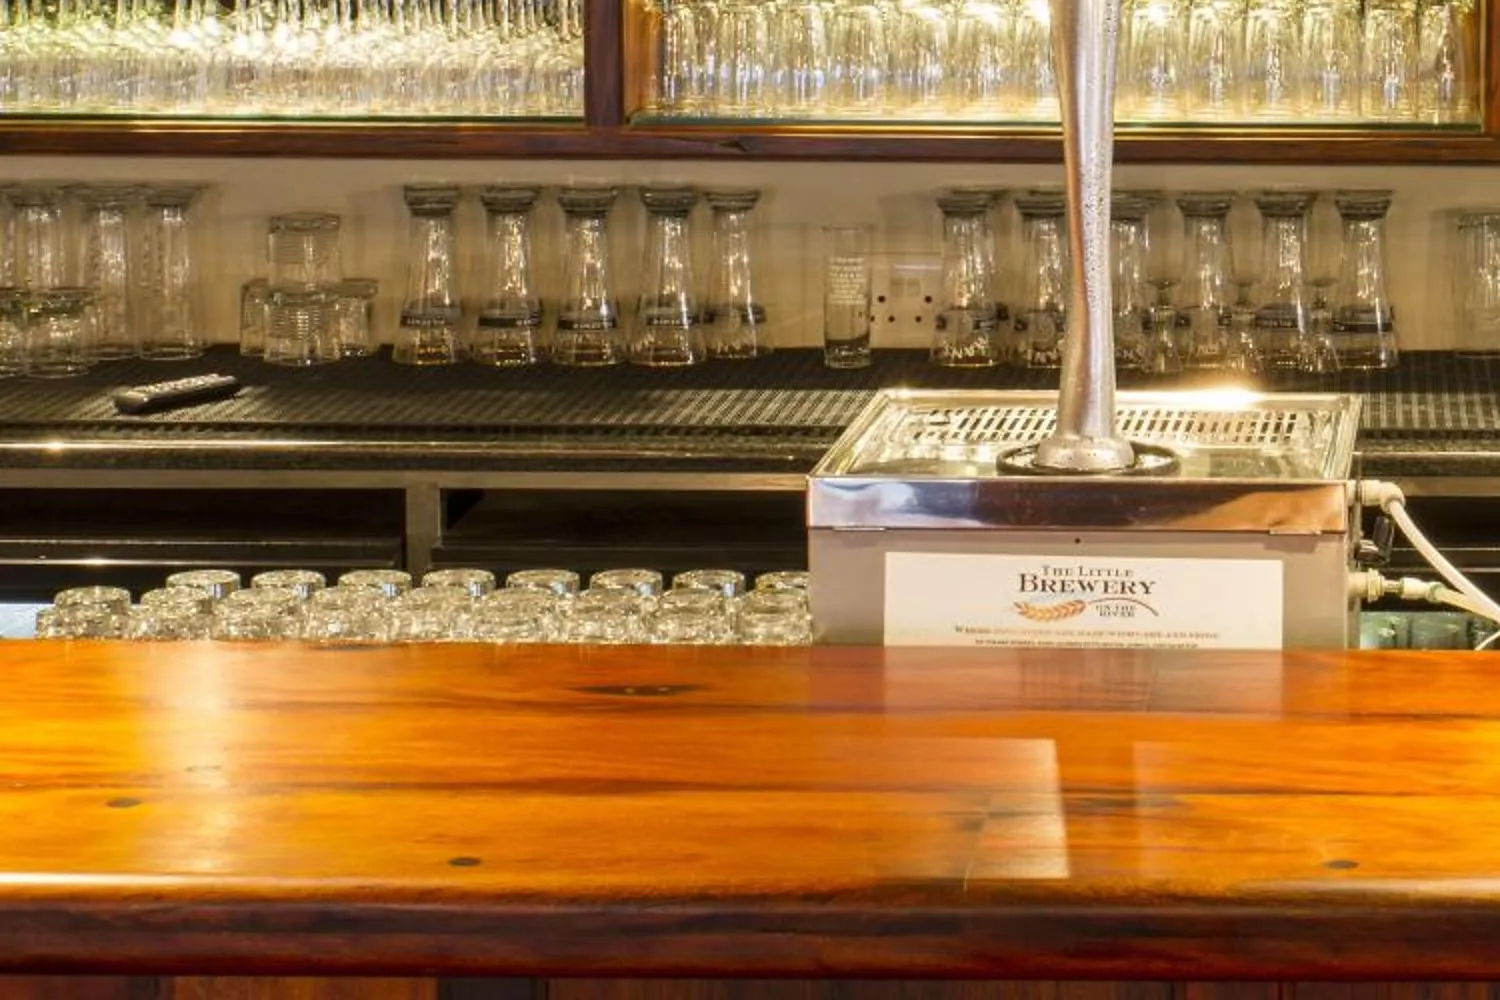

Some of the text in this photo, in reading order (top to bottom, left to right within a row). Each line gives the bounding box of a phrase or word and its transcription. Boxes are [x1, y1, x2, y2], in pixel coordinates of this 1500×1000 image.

[1043, 565, 1134, 578] THE LITTLE
[1019, 573, 1157, 595] BREWERY
